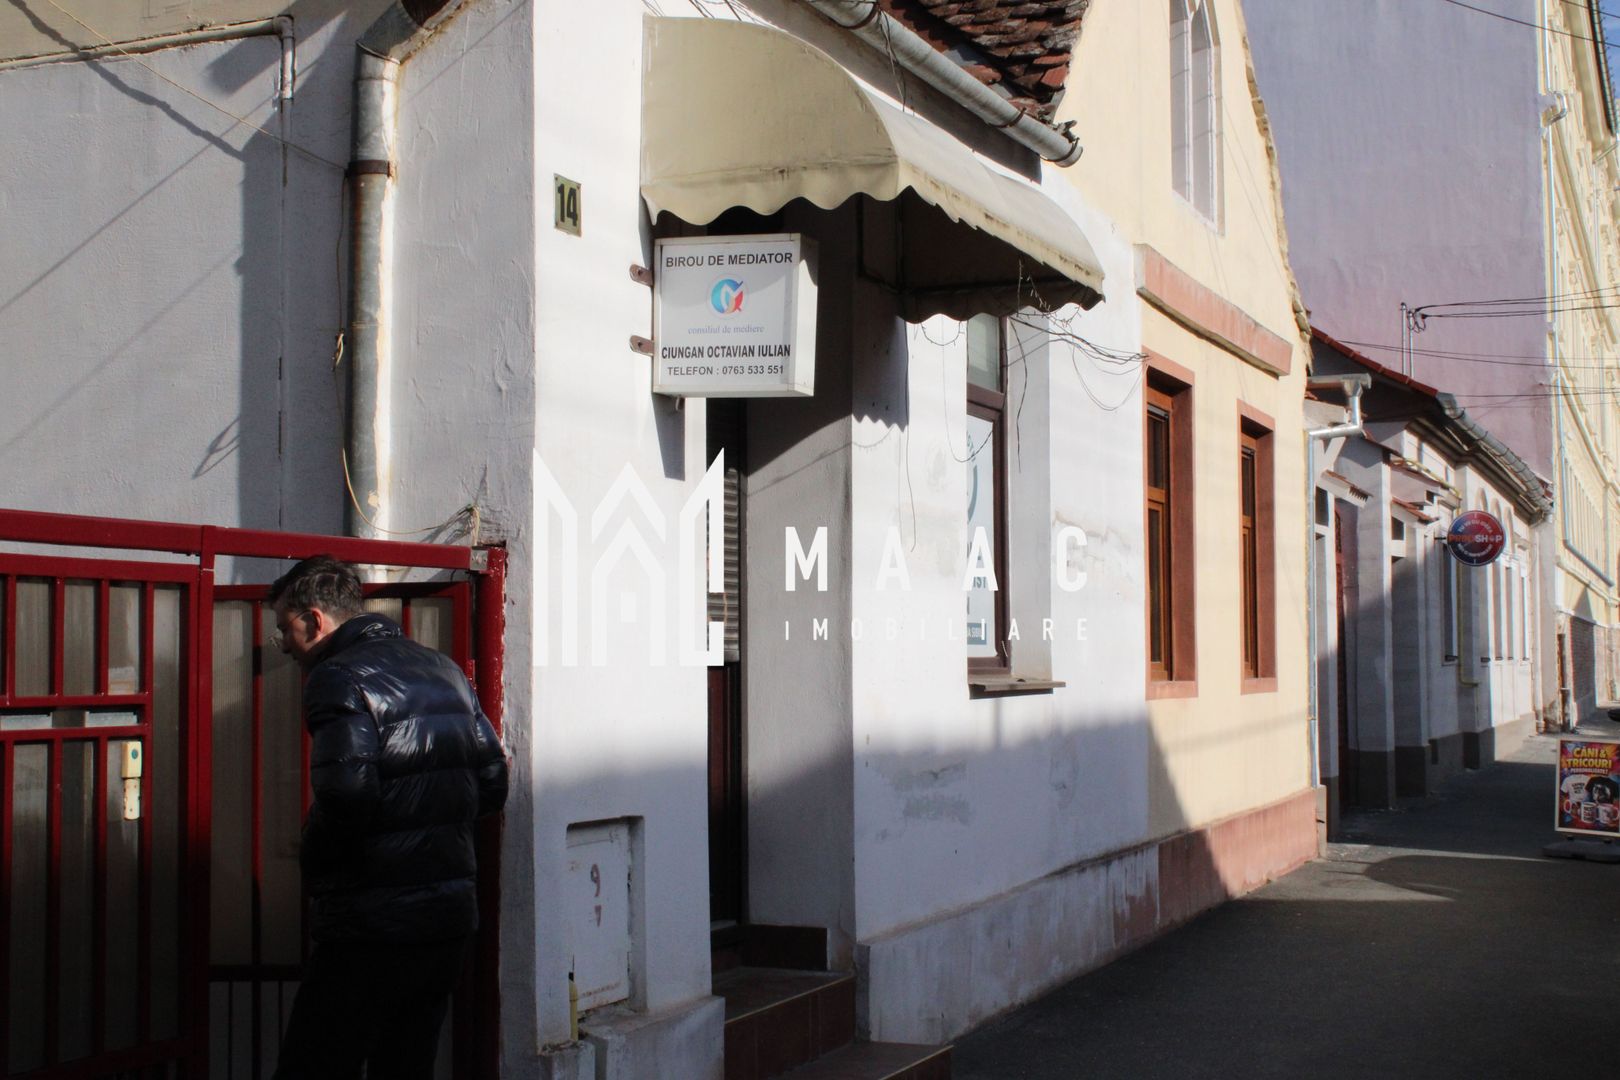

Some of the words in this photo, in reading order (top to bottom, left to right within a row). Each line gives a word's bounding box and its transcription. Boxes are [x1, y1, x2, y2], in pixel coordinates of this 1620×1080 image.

[557, 183, 578, 227] 14
[665, 256, 704, 268] BIROU
[708, 255, 725, 266] DE
[728, 252, 793, 265] MEDIATOR
[722, 325, 732, 334] de
[661, 346, 704, 359] CIUNGAN
[707, 345, 755, 358] OCTAVIAN
[758, 344, 791, 357] IULIAN
[667, 366, 713, 376] TELEFON
[722, 365, 745, 375] 0763
[747, 365, 765, 374] 533
[767, 365, 784, 374] 551
[1567, 759, 1612, 768] TRICOURI
